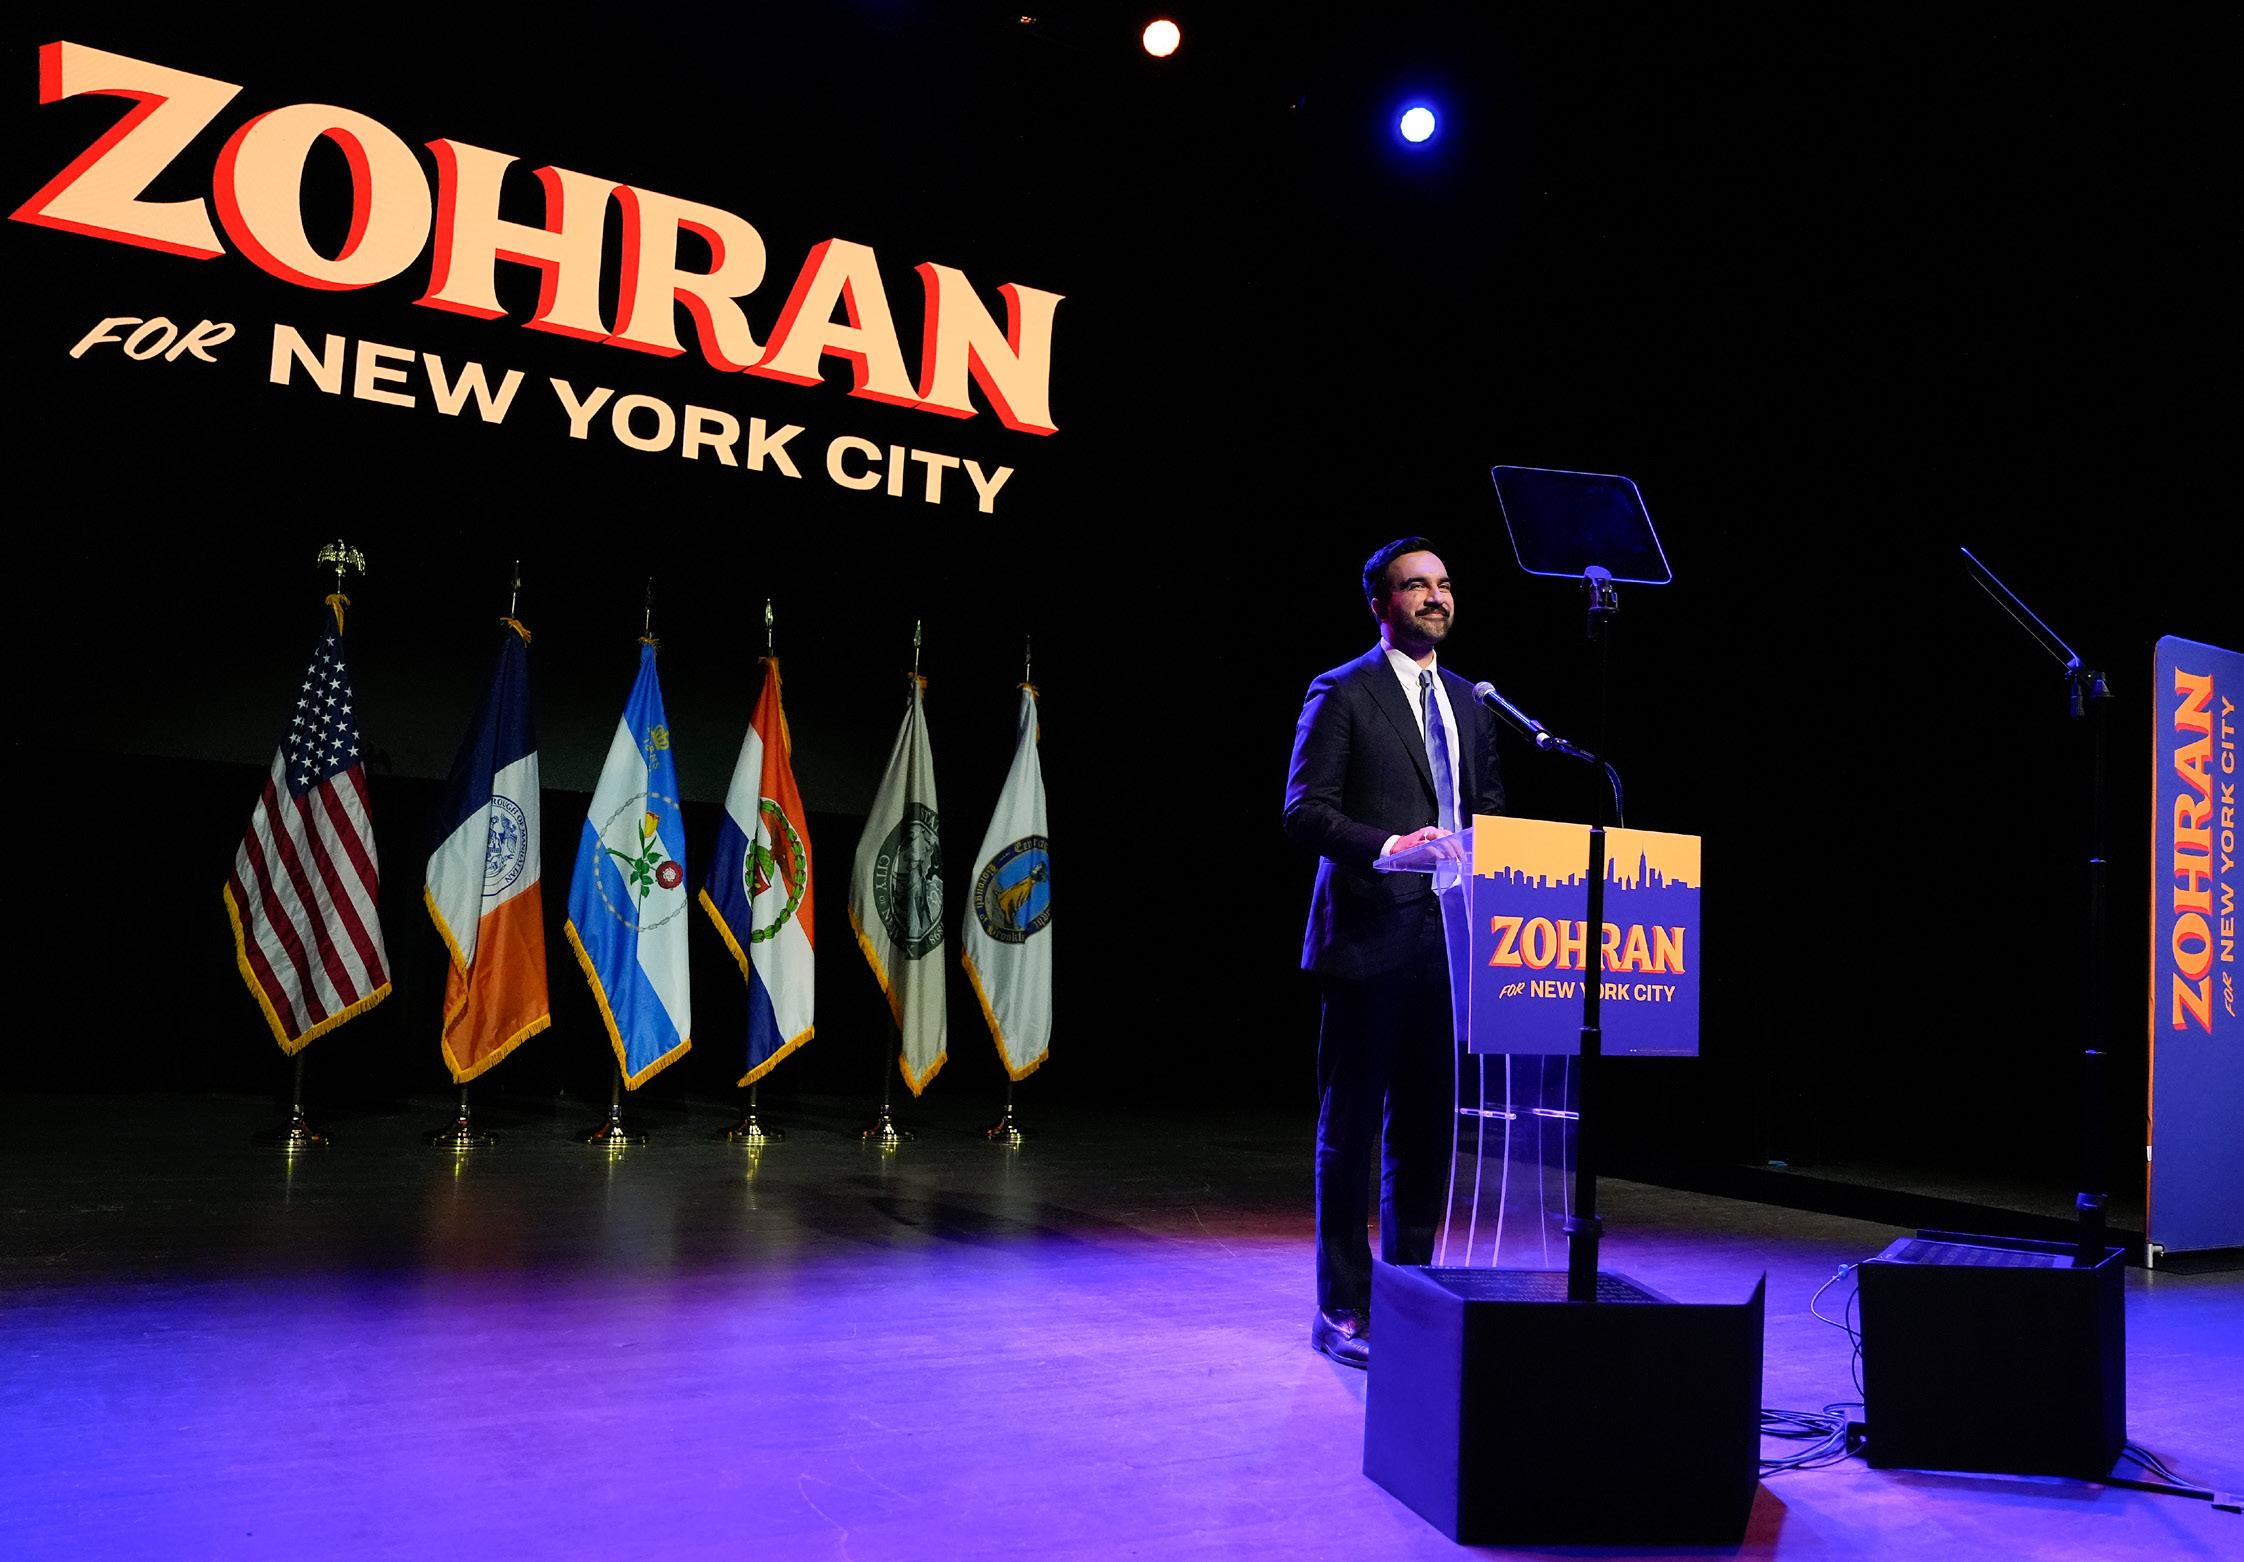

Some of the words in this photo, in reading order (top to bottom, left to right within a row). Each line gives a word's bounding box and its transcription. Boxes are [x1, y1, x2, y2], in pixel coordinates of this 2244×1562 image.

[7, 39, 1066, 437] ZOHRAN
[69, 316, 236, 363] FOR
[269, 323, 526, 425] NEW
[549, 377, 806, 479] YORK
[826, 435, 1015, 514] CITY
[2221, 695, 2235, 774] CITY
[2171, 666, 2215, 1036] ZOHRAN
[2220, 781, 2235, 874] YORK
[876, 854, 892, 890] CITY
[1488, 915, 1686, 975] ZOHRAN
[2220, 882, 2235, 962] NEW
[1499, 982, 1526, 1000] FOR
[1530, 980, 1576, 999] NEW
[1633, 983, 1676, 1002] CITY
[2223, 971, 2237, 1018] FOR
